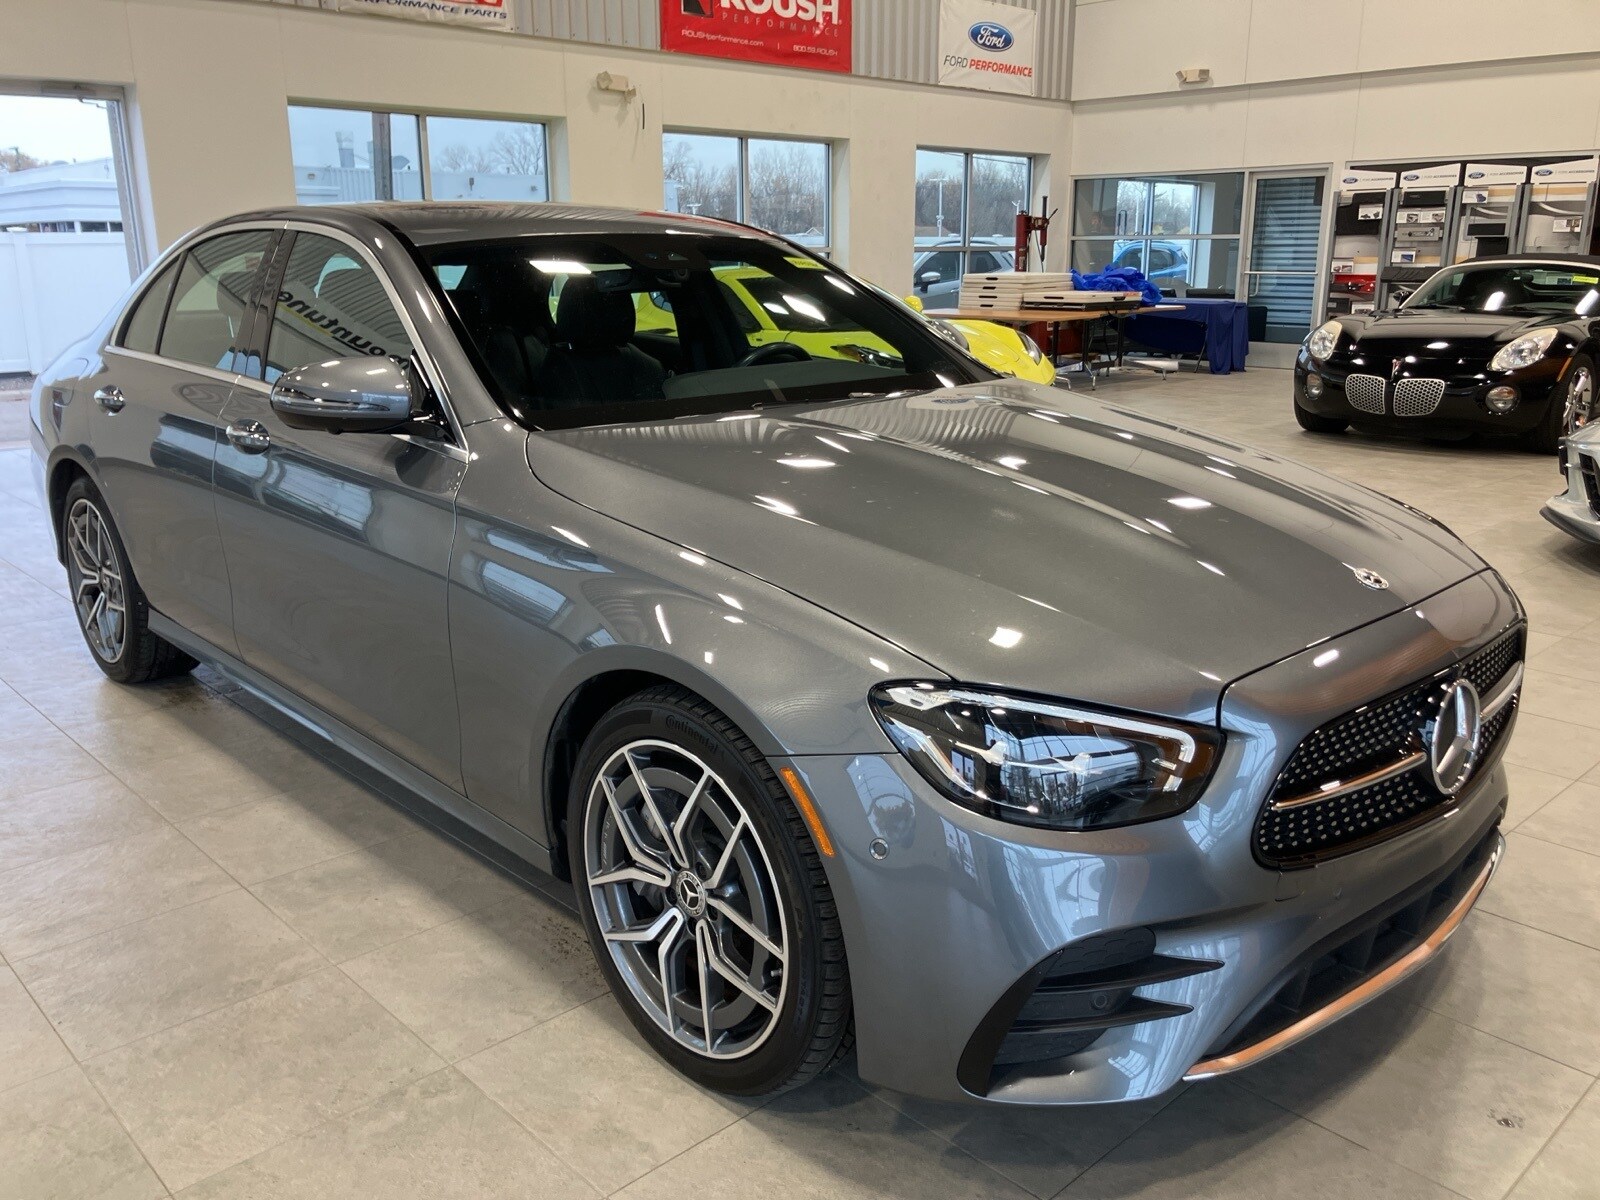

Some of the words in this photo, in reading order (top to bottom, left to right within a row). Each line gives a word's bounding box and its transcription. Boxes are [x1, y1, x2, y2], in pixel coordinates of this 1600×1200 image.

[464, 7, 507, 19] PARTS
[722, 13, 839, 37] PERFORMANCE
[681, 29, 764, 47] ROUSHperformance.com
[977, 25, 1006, 48] Ford
[943, 55, 968, 68] FORD
[969, 59, 1033, 77] PERFORMANCE
[665, 714, 719, 754] Continental
